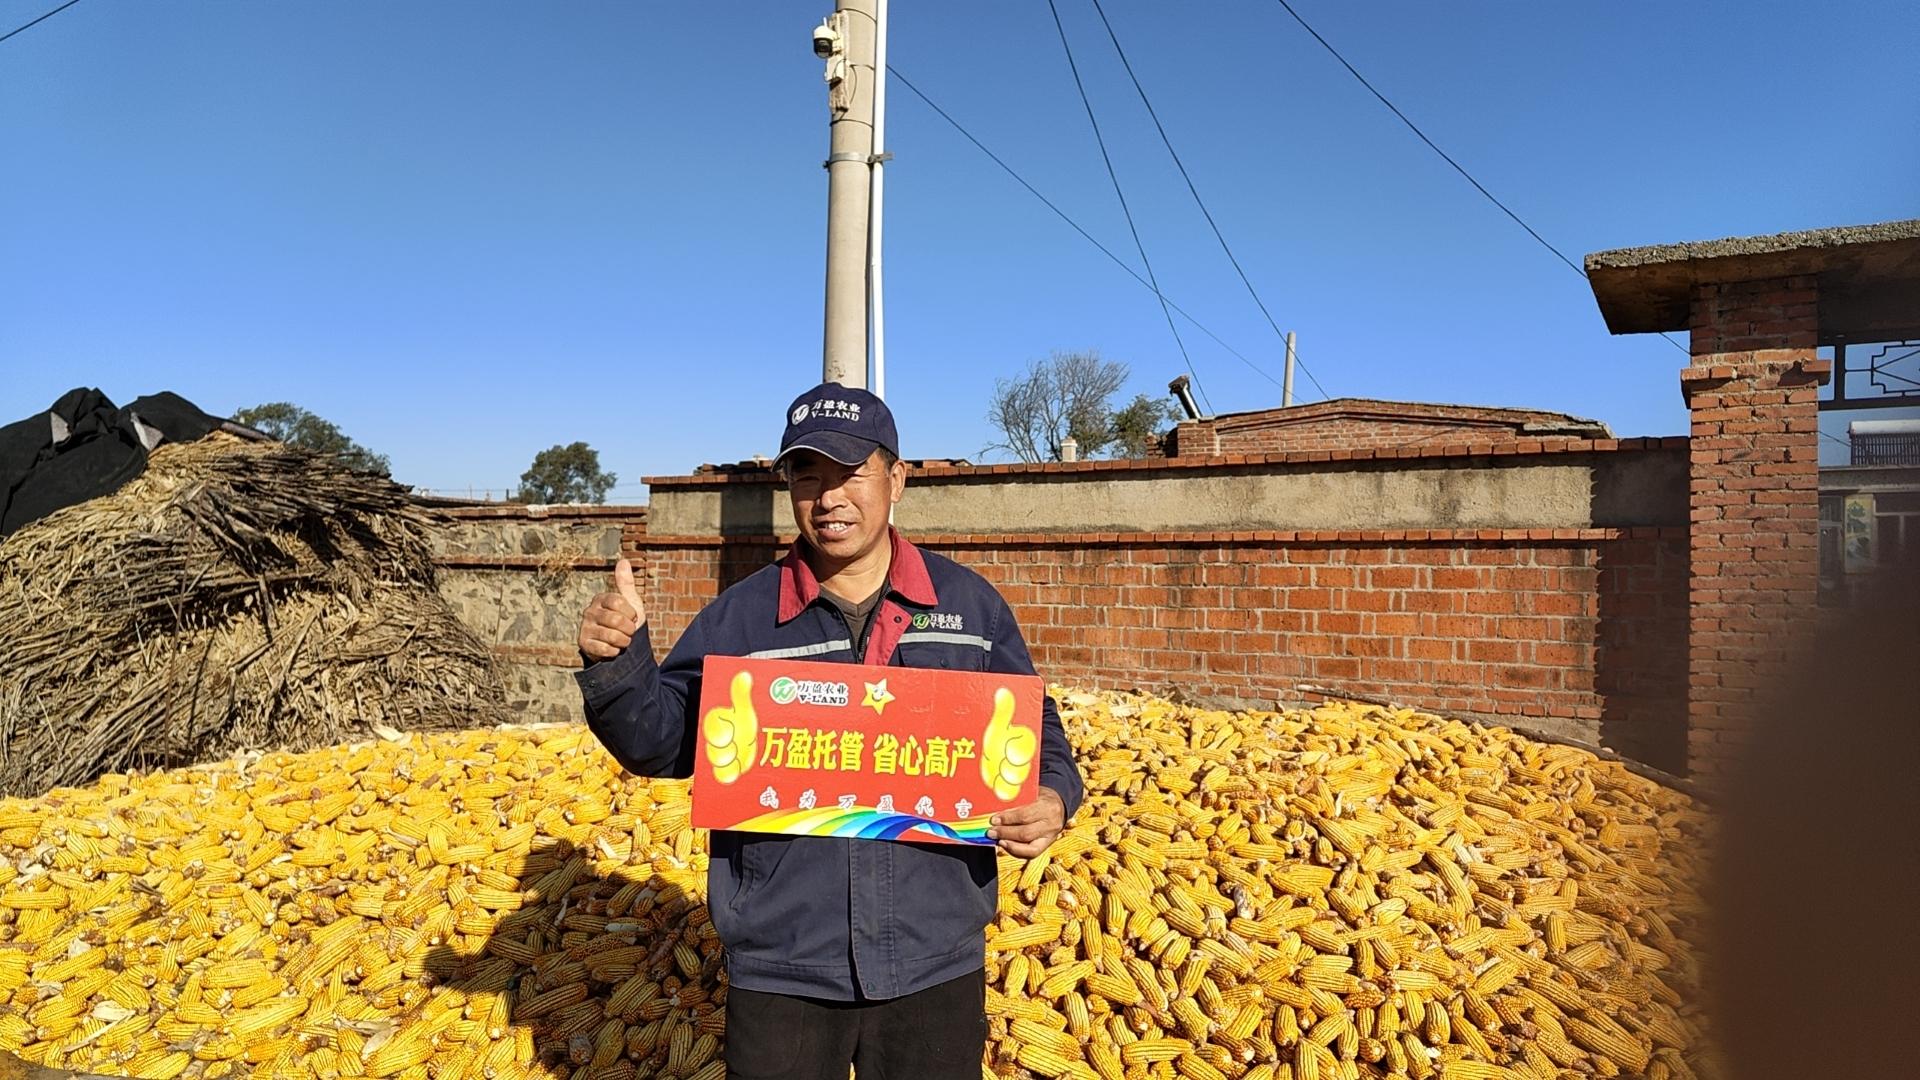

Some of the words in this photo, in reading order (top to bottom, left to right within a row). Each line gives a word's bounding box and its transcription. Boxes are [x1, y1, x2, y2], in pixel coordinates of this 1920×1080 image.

[811, 410, 859, 422] V-LAND
[930, 622, 963, 630] V-LAND
[799, 694, 846, 704] V-LAND
[760, 727, 865, 771] 万盈托管
[873, 733, 976, 777] 省心高产
[760, 786, 972, 818] 我为万盈代言
